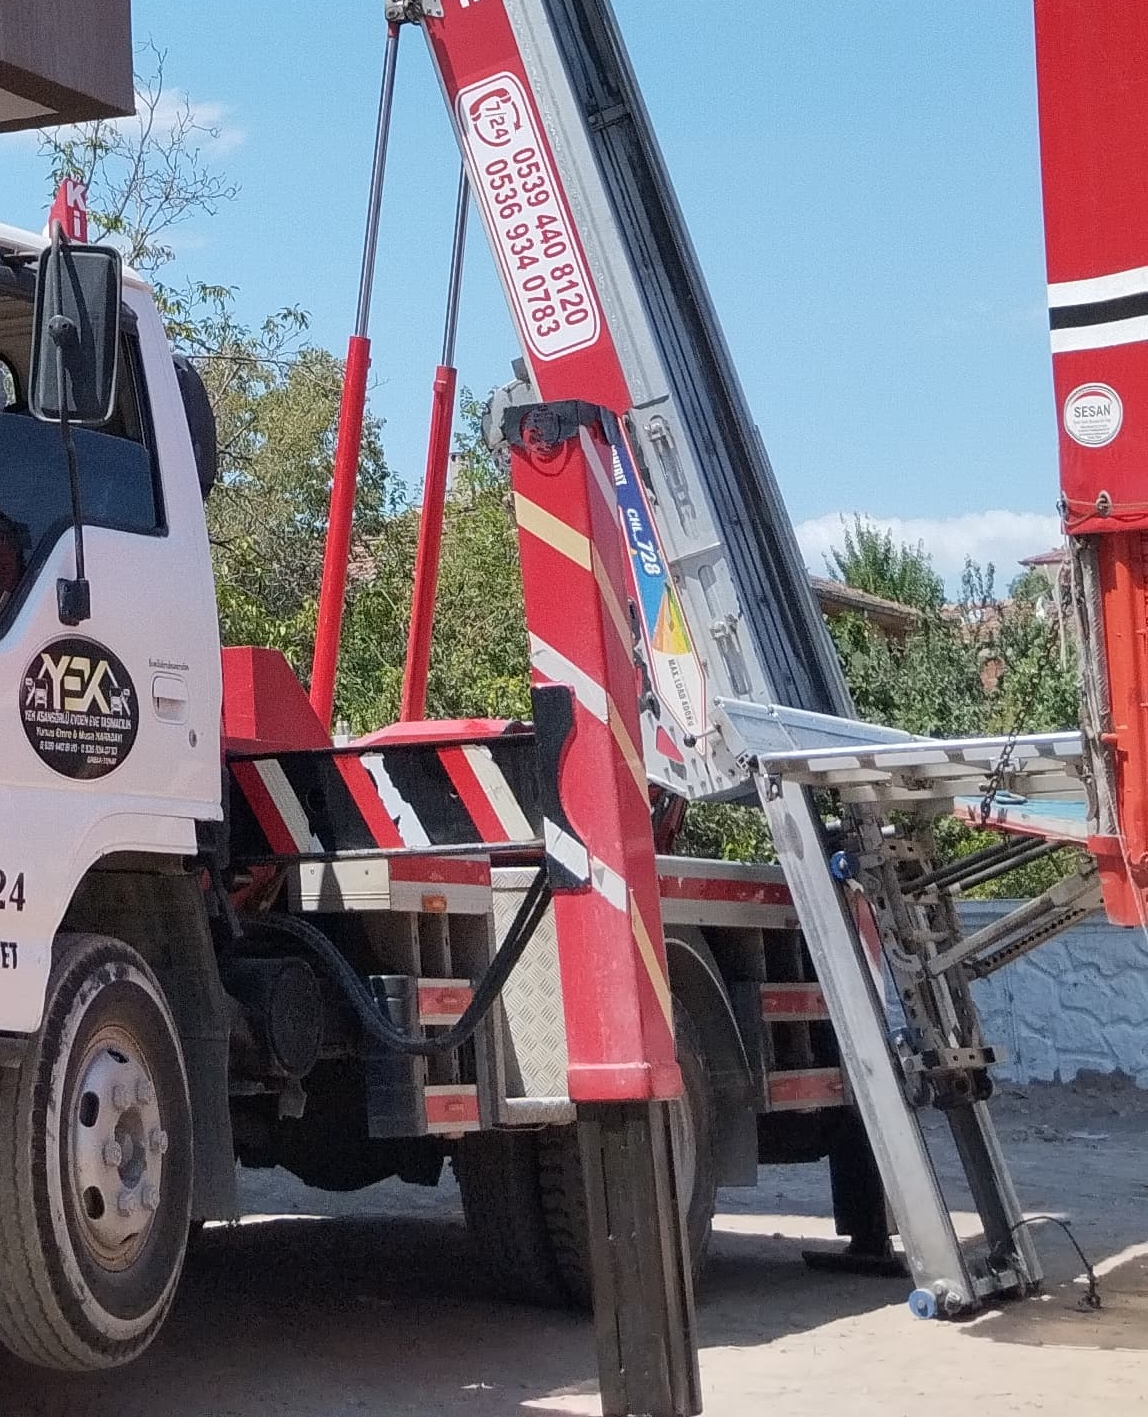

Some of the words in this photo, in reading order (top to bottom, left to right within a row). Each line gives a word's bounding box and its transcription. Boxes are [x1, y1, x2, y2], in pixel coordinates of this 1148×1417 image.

[484, 100, 510, 140] 7/24
[485, 159, 522, 219] 0536
[512, 147, 550, 207] 0539
[506, 223, 540, 271] 934
[535, 214, 567, 259] 440
[522, 274, 561, 337] 0783
[550, 263, 589, 326] 8120
[1074, 404, 1111, 418] SESAN
